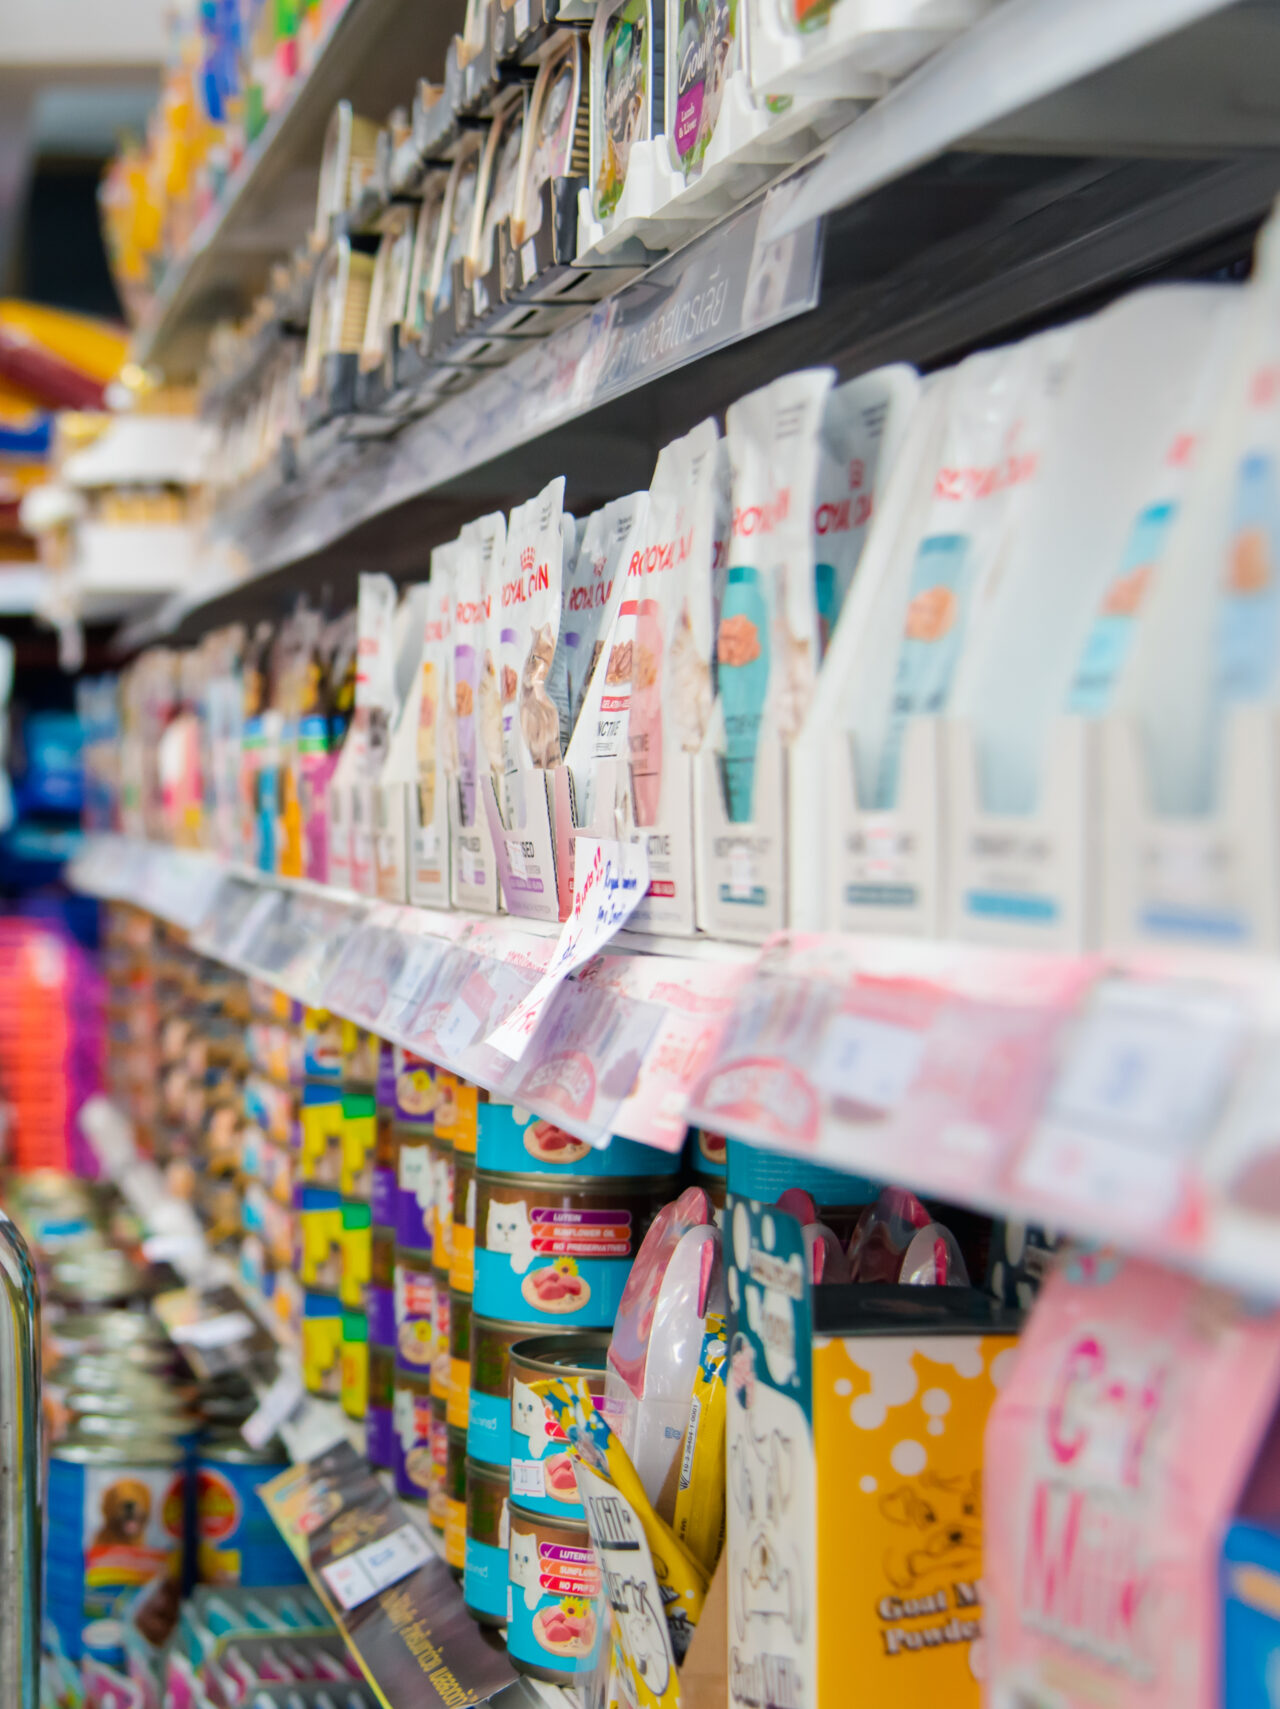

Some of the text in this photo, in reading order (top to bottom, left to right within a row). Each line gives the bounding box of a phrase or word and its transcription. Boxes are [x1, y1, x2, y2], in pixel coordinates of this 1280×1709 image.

[553, 1213, 582, 1222] LUTEIN
[559, 1549, 586, 1561] LUTEIN
[559, 1581, 570, 1590] NO
[876, 1594, 948, 1621] Goat
